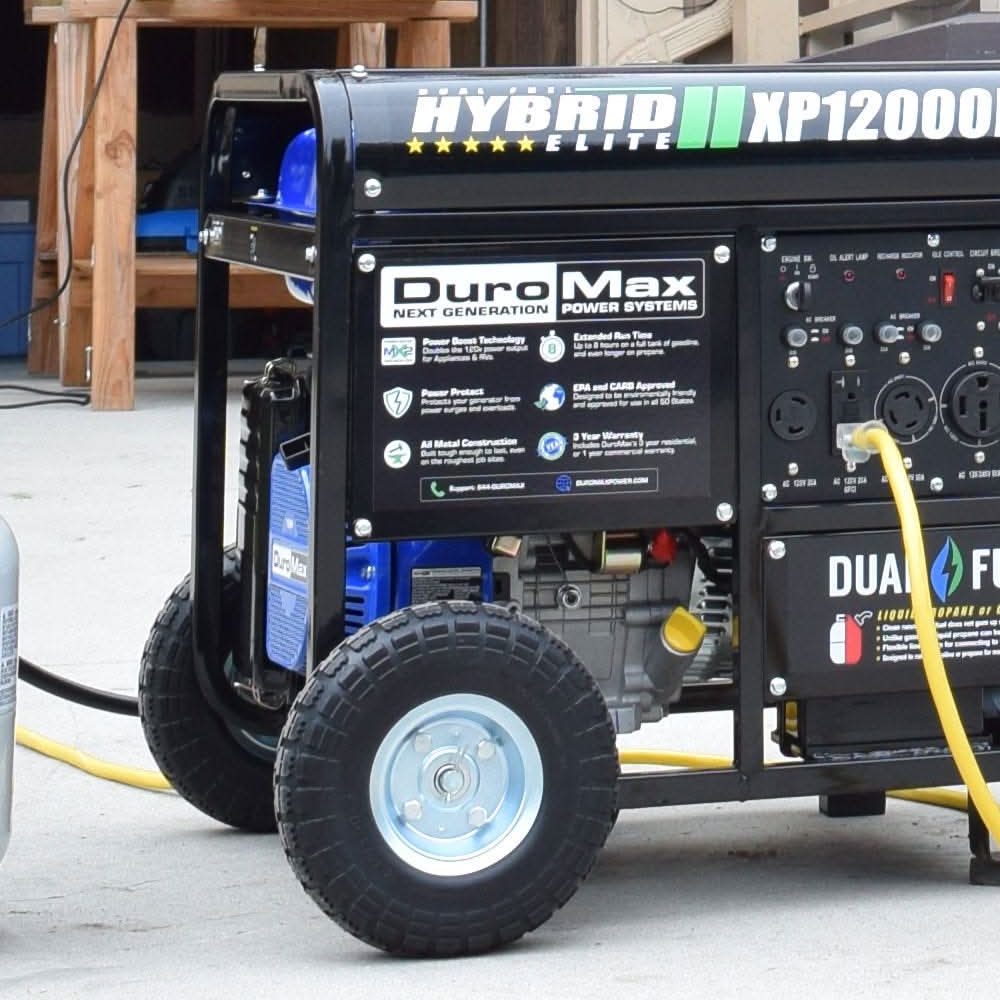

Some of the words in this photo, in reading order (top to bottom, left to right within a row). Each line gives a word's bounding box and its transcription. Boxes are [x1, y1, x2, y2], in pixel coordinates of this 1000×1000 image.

[411, 93, 677, 133] HYBRID
[545, 132, 672, 152] ELITE
[393, 309, 436, 319] NEXT
[442, 304, 549, 318] GENERATION
[561, 302, 619, 314] POWER
[623, 299, 697, 313] SYSTEMS
[636, 381, 676, 391] Approved
[450, 388, 485, 397] Protect
[581, 433, 601, 441] Year
[602, 432, 644, 442] Warranty
[434, 439, 460, 449] Metal
[462, 438, 518, 448] Construction
[979, 606, 992, 616] or
